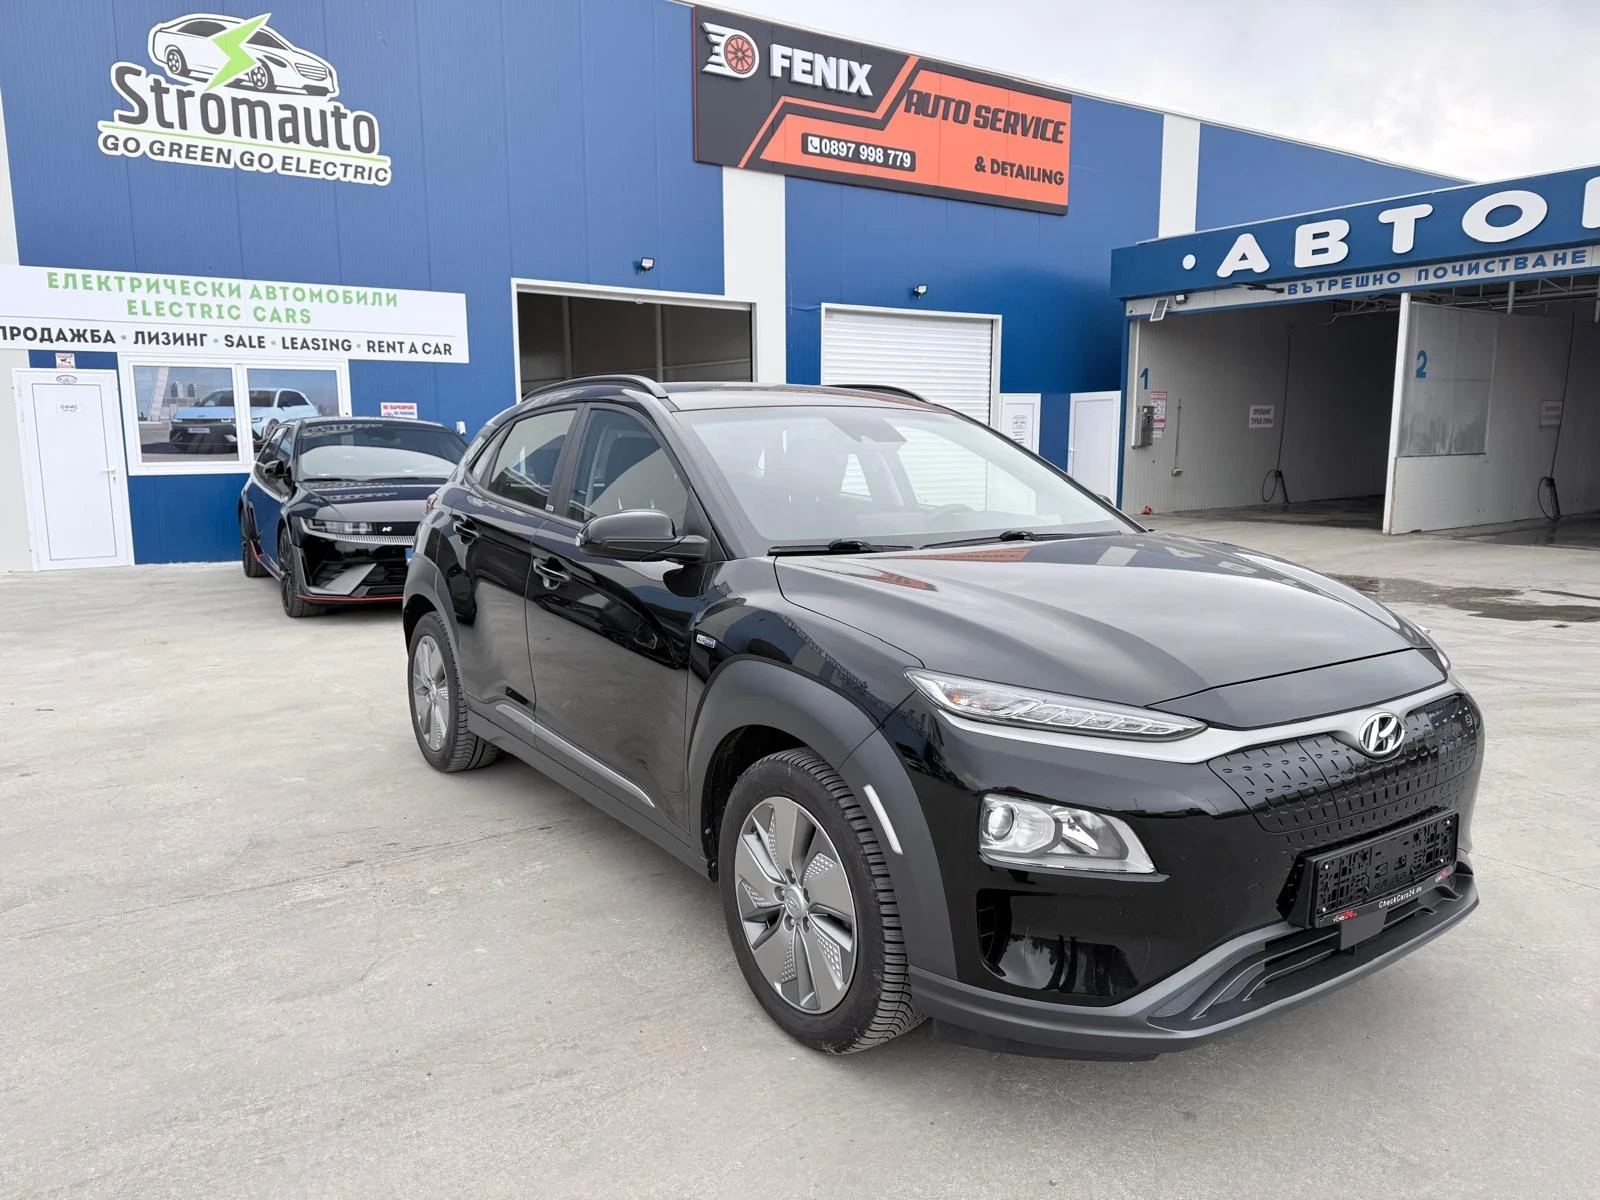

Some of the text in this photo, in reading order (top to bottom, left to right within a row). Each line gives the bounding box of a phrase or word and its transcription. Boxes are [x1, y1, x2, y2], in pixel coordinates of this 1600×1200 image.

[769, 43, 874, 97] FENIX
[113, 64, 376, 154] Stromauto
[904, 89, 1067, 144] AUTO SERVICE
[102, 134, 389, 183] GO GREEN GO ELECTRIC
[821, 137, 911, 168] 0897 998 779
[974, 156, 1065, 186] & DETAILING
[1287, 247, 1587, 296] ВЪТРЕШНО ПОЧИСТВАНЕ
[47, 271, 398, 308] ЕЛЕКТРИЧЕСКИ АВТОМОБИЛИ
[127, 300, 312, 324] ELECTRIC CARS
[133, 330, 208, 348] ЛИЗИНГ
[224, 334, 266, 349] SALE
[281, 336, 352, 352] LEASING
[366, 339, 407, 354] RENT
[408, 342, 419, 355] A
[421, 342, 453, 356] CAR
[1140, 367, 1149, 390] 1
[1415, 350, 1428, 378] 2
